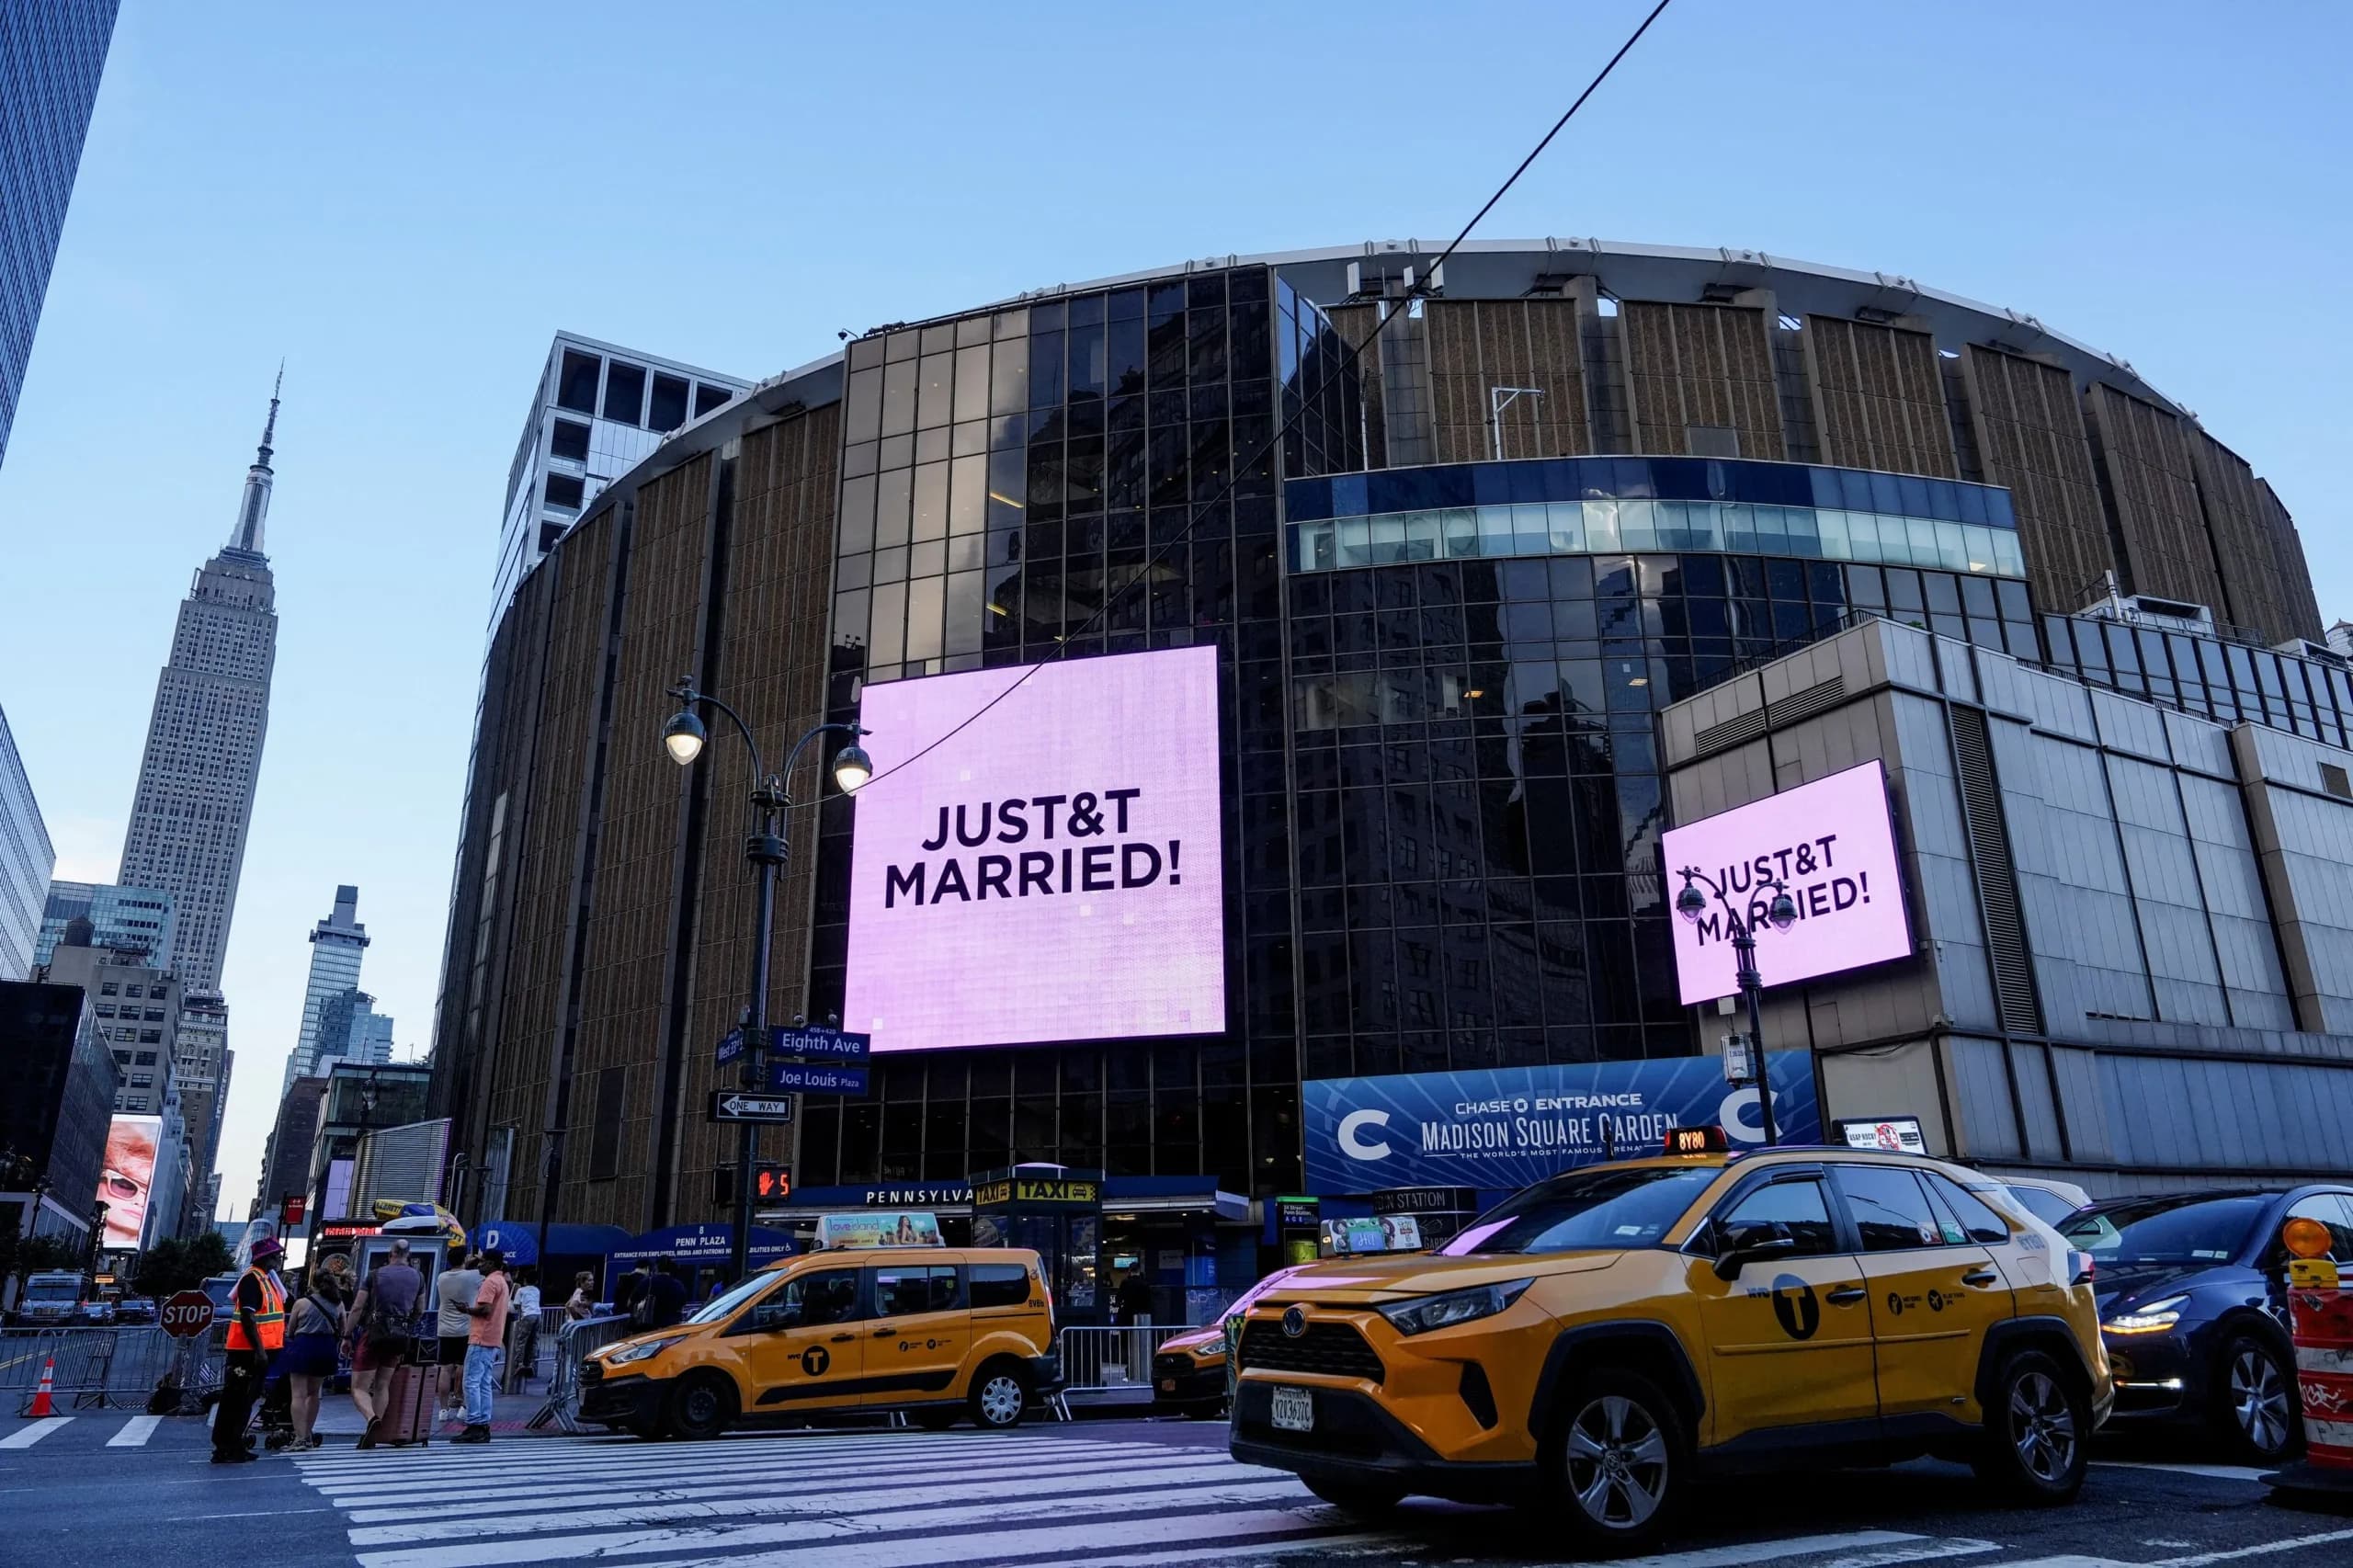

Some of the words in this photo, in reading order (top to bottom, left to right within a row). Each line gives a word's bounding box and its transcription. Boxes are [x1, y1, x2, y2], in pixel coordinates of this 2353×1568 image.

[922, 788, 1141, 852] JUST&T
[884, 839, 1182, 909] MARRIED!
[1713, 834, 1837, 899] JUST&T
[782, 1033, 828, 1052] Eighth
[833, 1038, 860, 1053] Ave
[779, 1070, 801, 1085] Joe
[805, 1072, 837, 1087] Louis
[840, 1078, 859, 1087] Plaza
[729, 1101, 749, 1110] ONE
[758, 1102, 779, 1111] WAY
[1455, 1101, 1510, 1115] CHASE
[1535, 1093, 1643, 1111] ENTRANCE
[1337, 1108, 1392, 1161] C
[1421, 1121, 1510, 1152] MADISON
[1517, 1116, 1591, 1150] SQUARE
[1678, 1131, 1705, 1151] 8Y80
[1483, 1150, 1527, 1158] WORLD'S
[1562, 1146, 1603, 1155] FAMOUS
[1613, 1144, 1643, 1153] RENA
[780, 1174, 789, 1195] 5
[978, 1184, 999, 1205] TAXI
[1021, 1182, 1068, 1199] TAXI
[1397, 1191, 1446, 1210] STATION
[485, 1230, 499, 1249] D
[699, 1225, 705, 1235] 8
[676, 1237, 696, 1247] PENN
[699, 1236, 726, 1246] PLAZA
[164, 1305, 211, 1324] STOP
[1780, 1288, 1805, 1331] T
[807, 1351, 824, 1372] T
